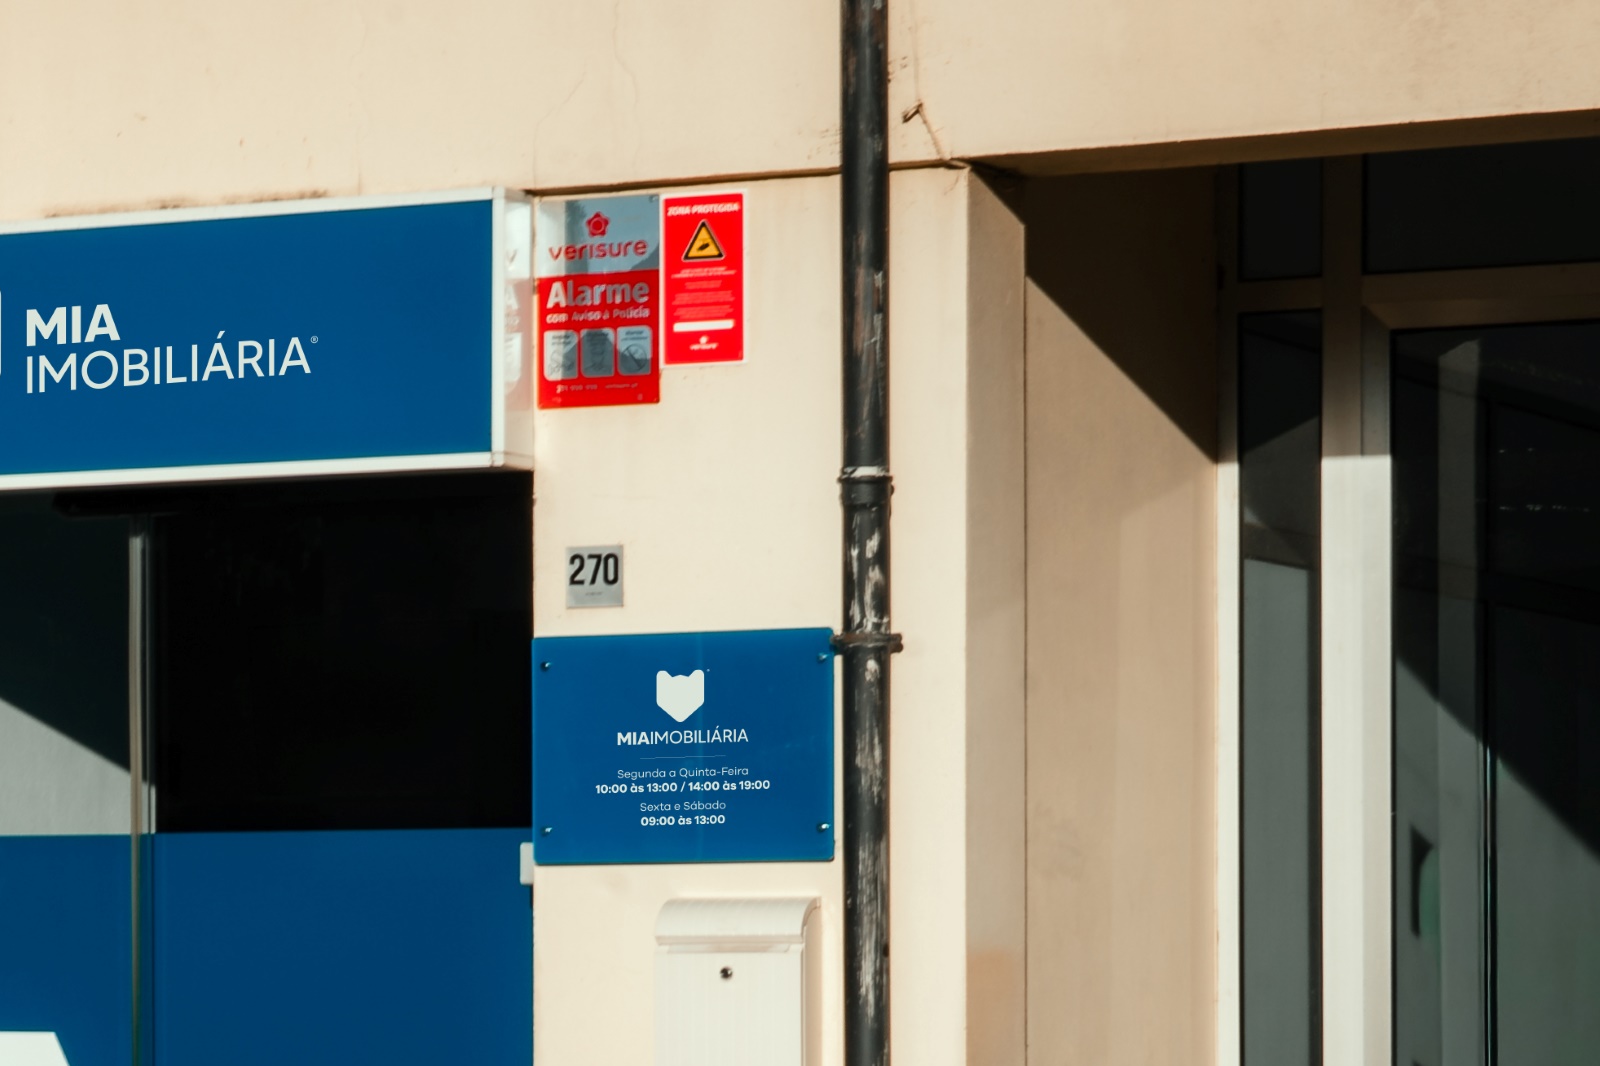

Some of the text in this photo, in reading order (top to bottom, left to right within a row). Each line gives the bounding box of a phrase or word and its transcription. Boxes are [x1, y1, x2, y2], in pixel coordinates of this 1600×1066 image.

[548, 239, 648, 261] verisure
[546, 279, 650, 309] Alarme
[26, 303, 121, 347] MIA
[568, 552, 619, 586] 270
[616, 725, 749, 746] MIAIMOBILIÁRIA
[617, 766, 749, 780] Segunda a Quinta-Feira
[595, 780, 771, 794] 10:00 às 13:00 / 14:00 às 19:00
[639, 800, 727, 812] Sexta e Sábado
[640, 814, 726, 827] 09:00 às 13:00
